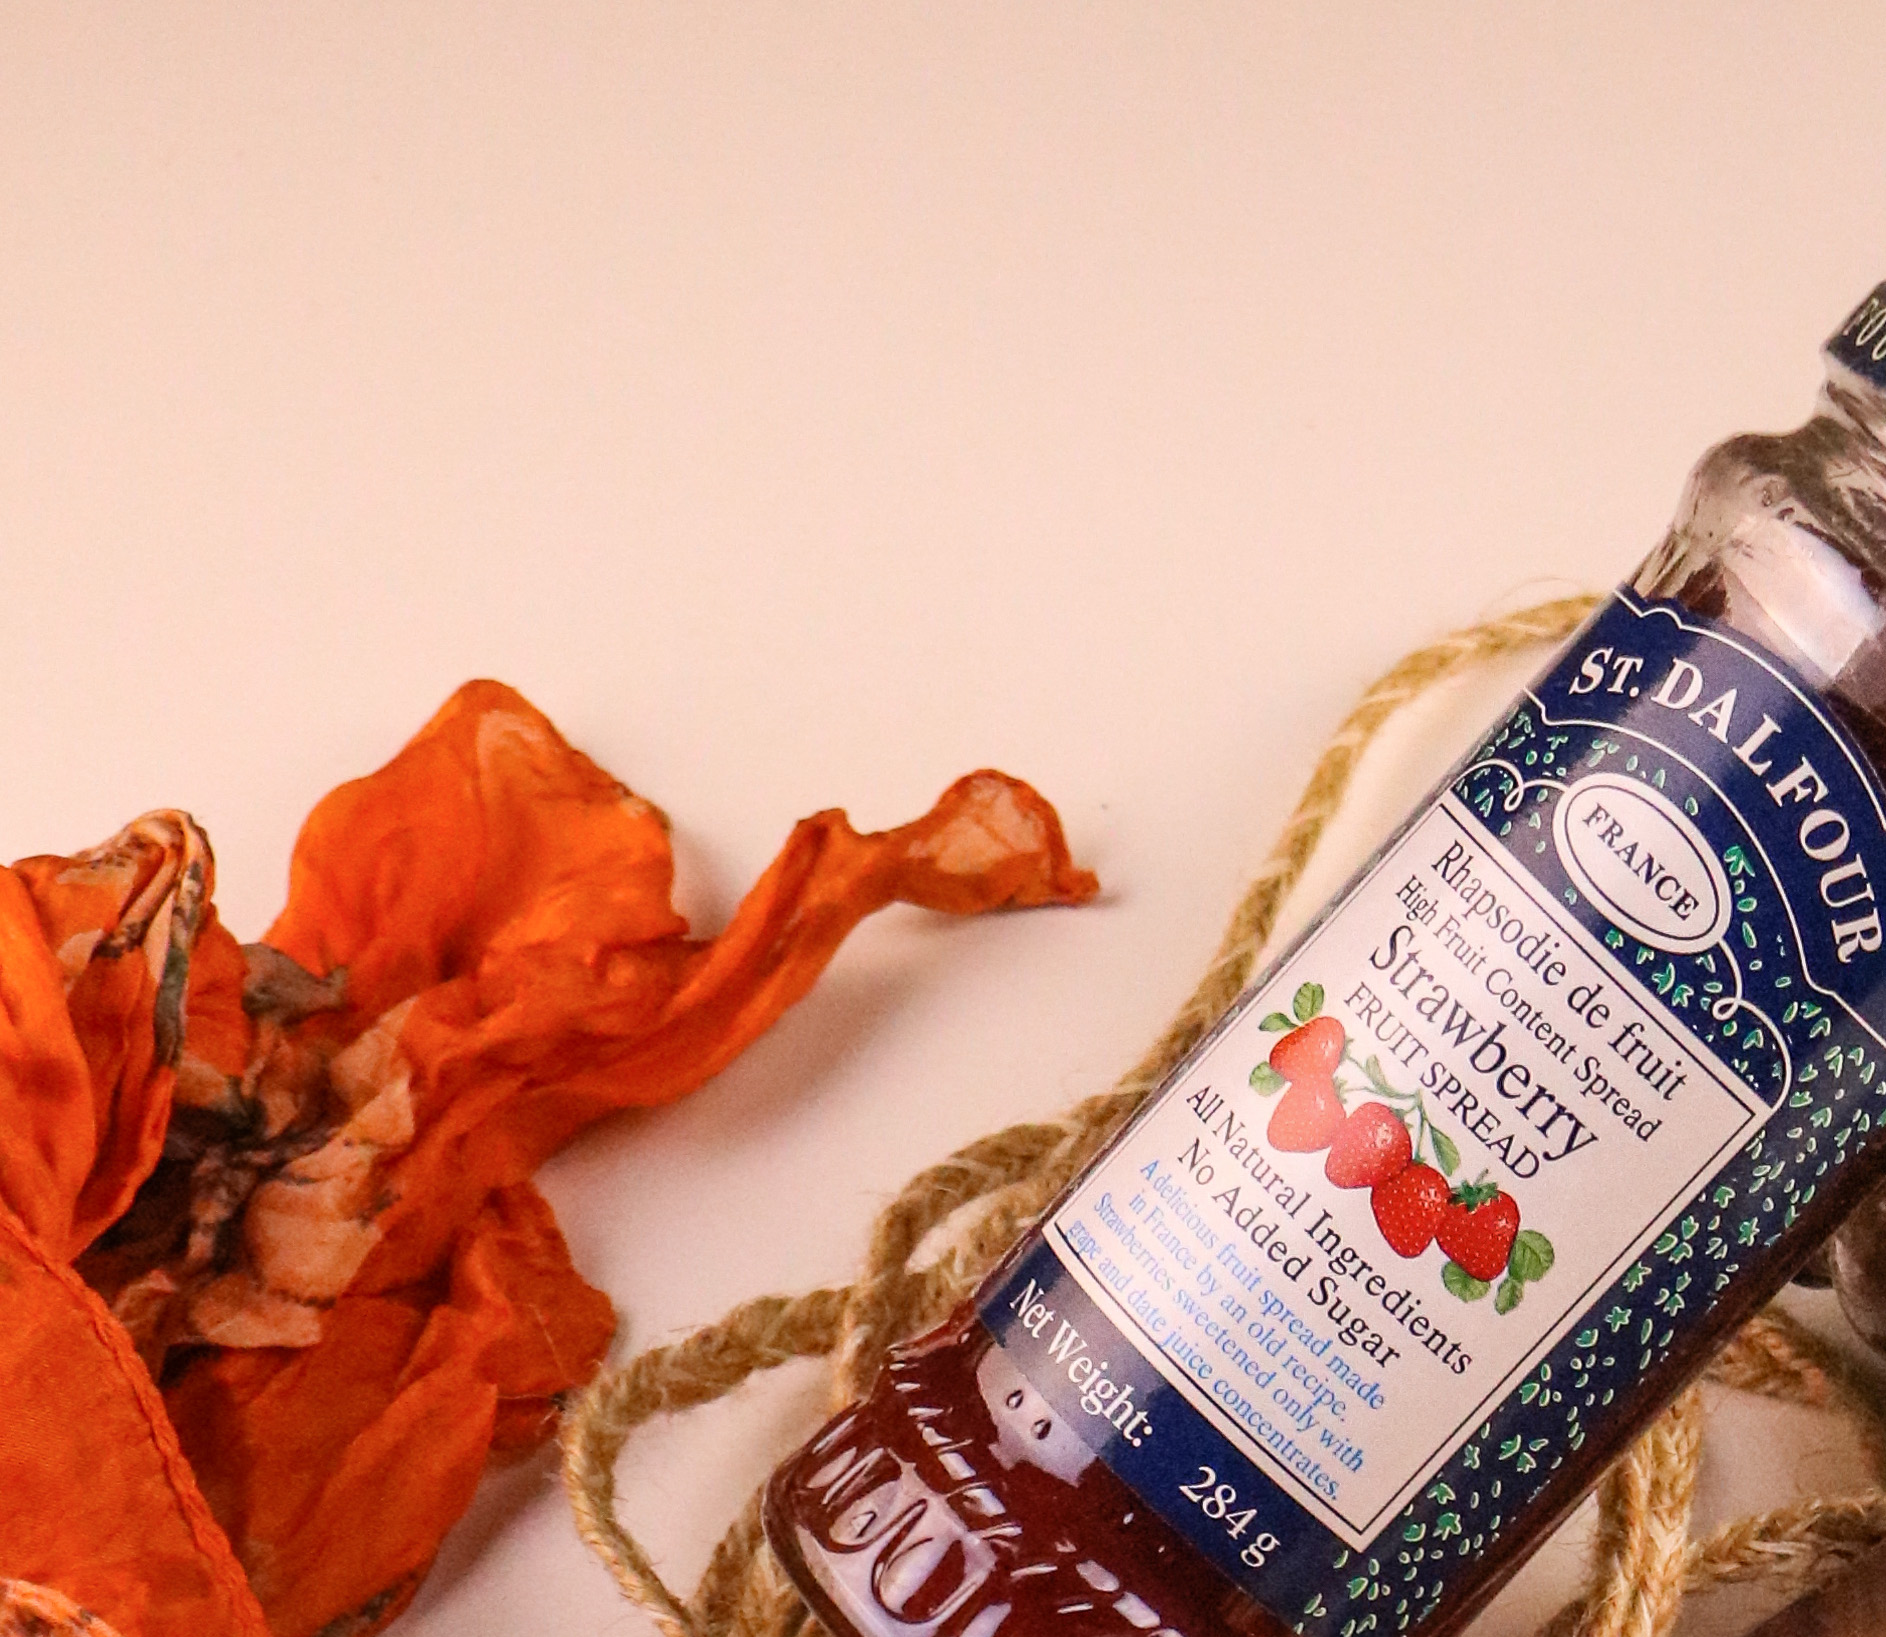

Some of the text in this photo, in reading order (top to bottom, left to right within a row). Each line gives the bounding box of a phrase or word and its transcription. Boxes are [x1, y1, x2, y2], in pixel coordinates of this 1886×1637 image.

[1568, 646, 1883, 964] ST. DALFOUR
[1582, 802, 1700, 921] FRANCE
[1343, 981, 1541, 1180] FRUIT SPREAD
[1368, 924, 1600, 1163] Strawberry
[1395, 874, 1664, 1143] High Fruit Content Spread
[1430, 839, 1688, 1102] Rhapsodie de fruit
[1065, 1220, 1341, 1502] grape and date juice concentrates.
[1093, 1191, 1365, 1474] Strawberries sweetened only with
[1129, 1194, 1347, 1423] in France by an old recipe.
[1139, 1159, 1386, 1411] A delicious fruit spread made
[1177, 1137, 1401, 1368] No Added Sugar
[1185, 1085, 1473, 1375] All Natural Ingredients
[1009, 1277, 1281, 1569] Net Weight: 284 g
